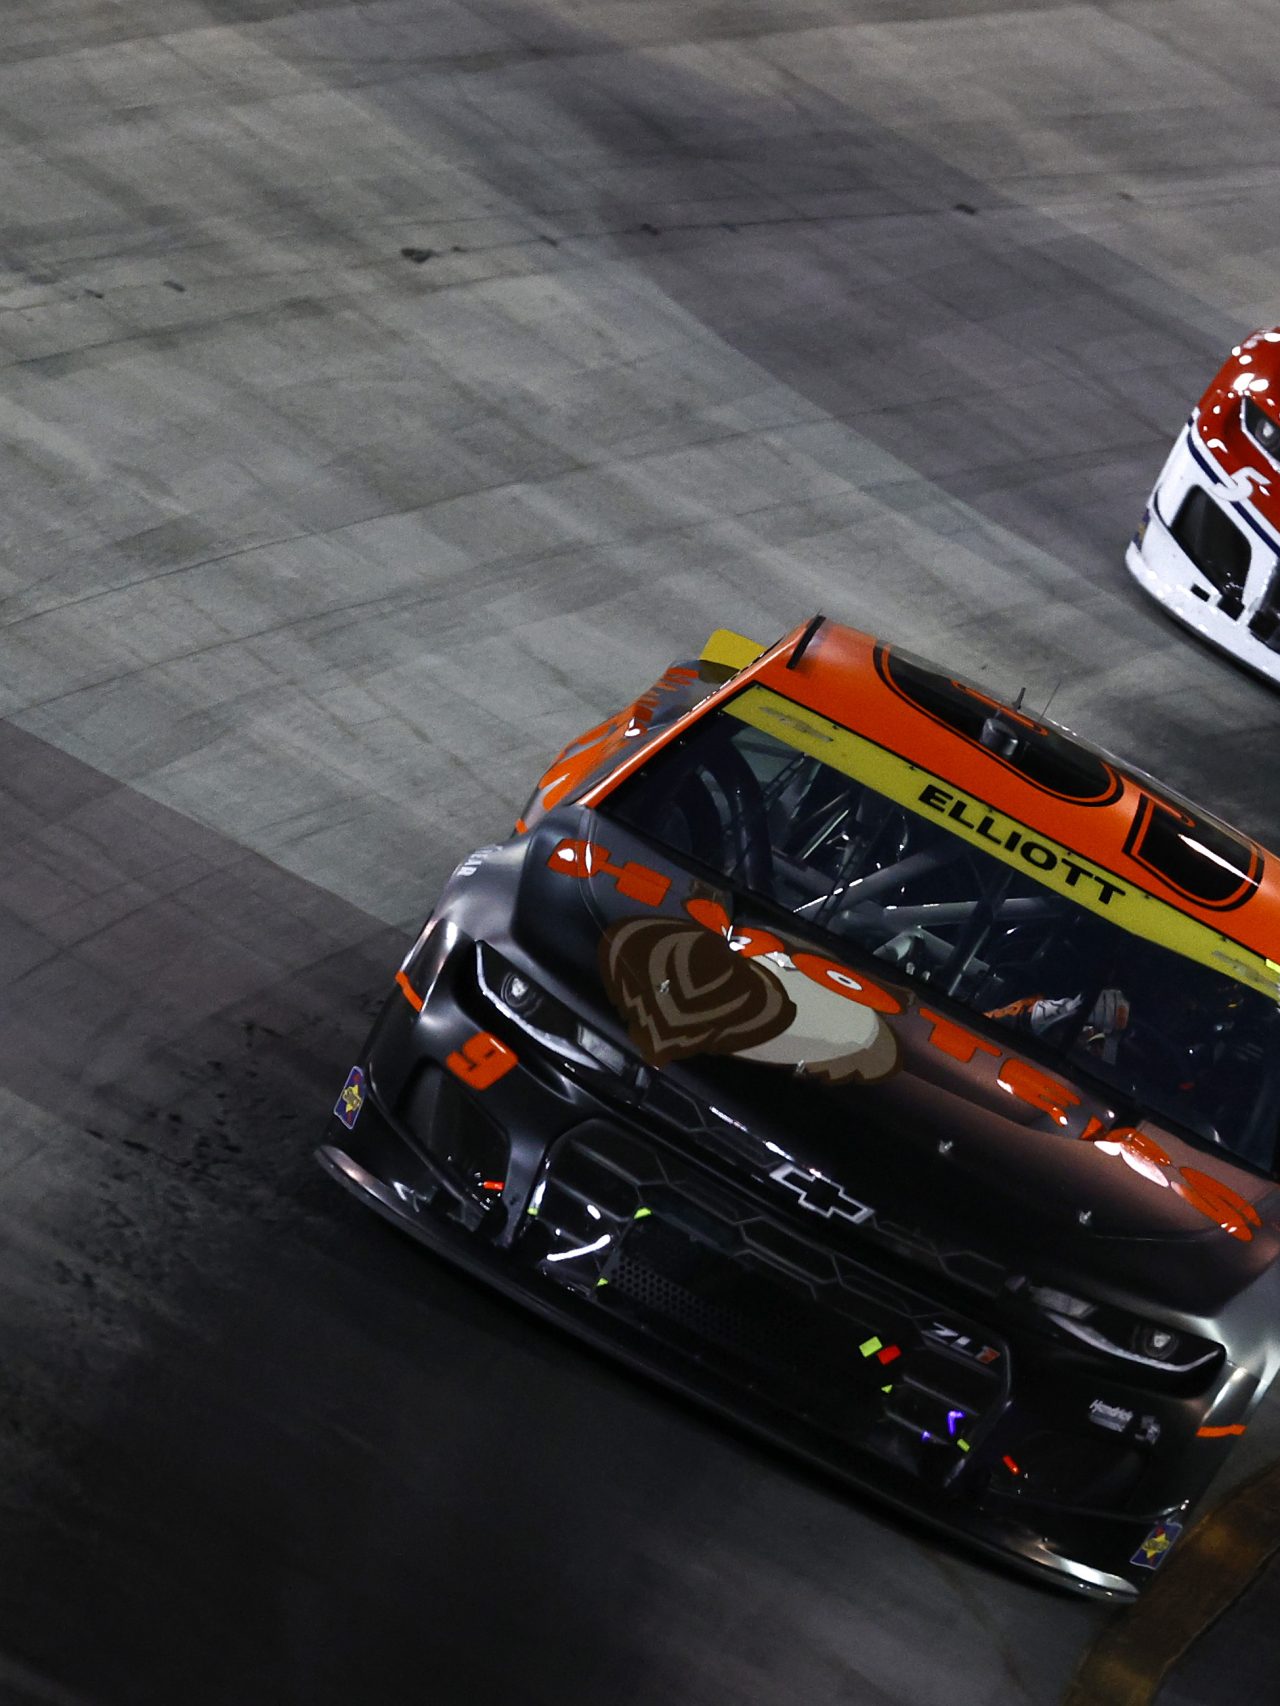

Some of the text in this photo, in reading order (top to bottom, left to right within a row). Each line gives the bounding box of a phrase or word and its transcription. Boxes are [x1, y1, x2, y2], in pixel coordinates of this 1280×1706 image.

[1207, 466, 1272, 502] 5
[917, 783, 1127, 905] ELLIOTT
[446, 1030, 519, 1092] 9
[920, 1321, 1001, 1365] ZL1
